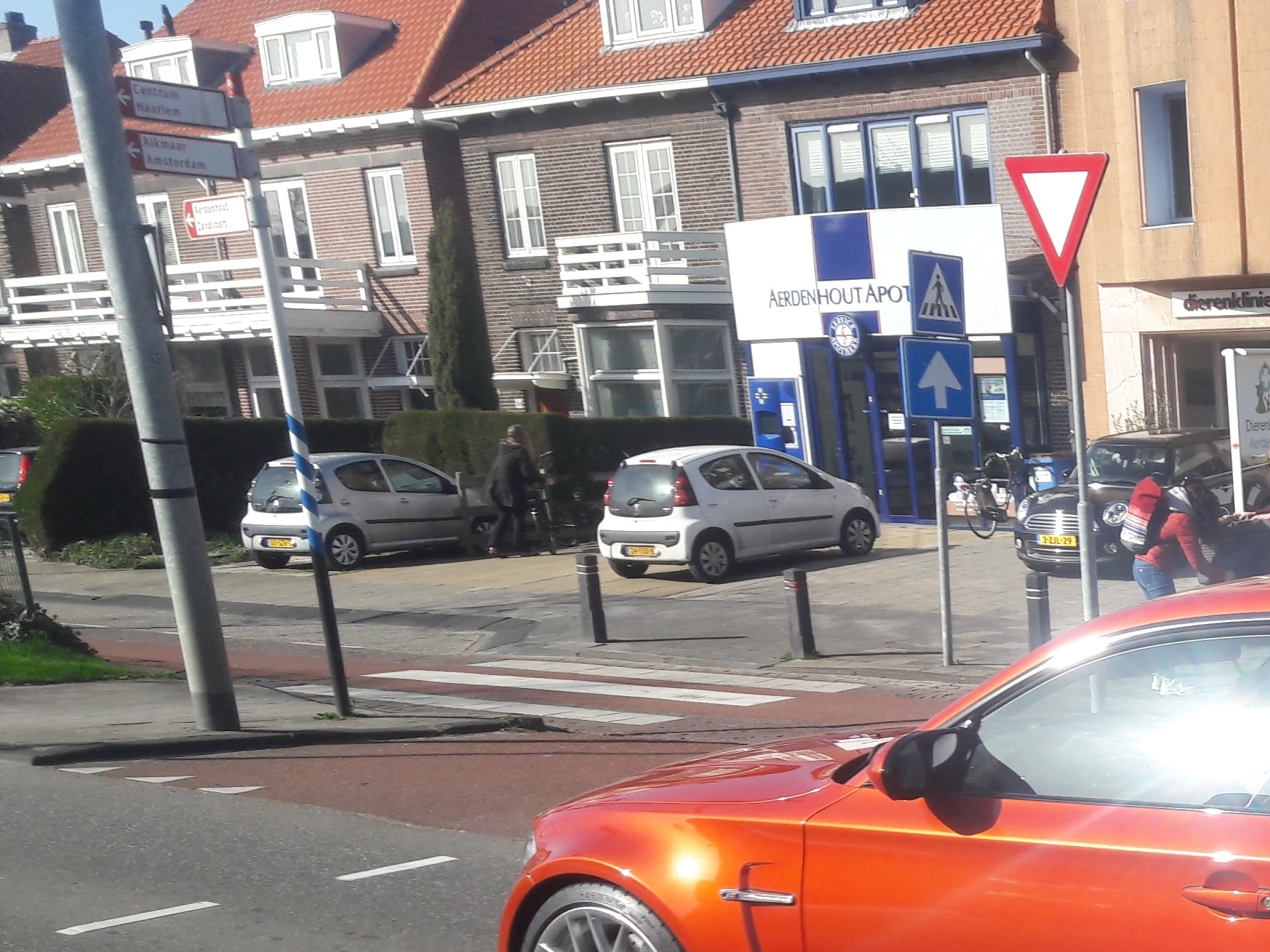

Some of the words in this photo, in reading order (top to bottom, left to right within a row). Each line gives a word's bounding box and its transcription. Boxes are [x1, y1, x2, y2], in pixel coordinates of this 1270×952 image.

[132, 83, 180, 100] Centrum
[135, 102, 181, 117] Haarlem
[142, 136, 187, 151] Alkmaar
[146, 154, 207, 170] Amsterdam
